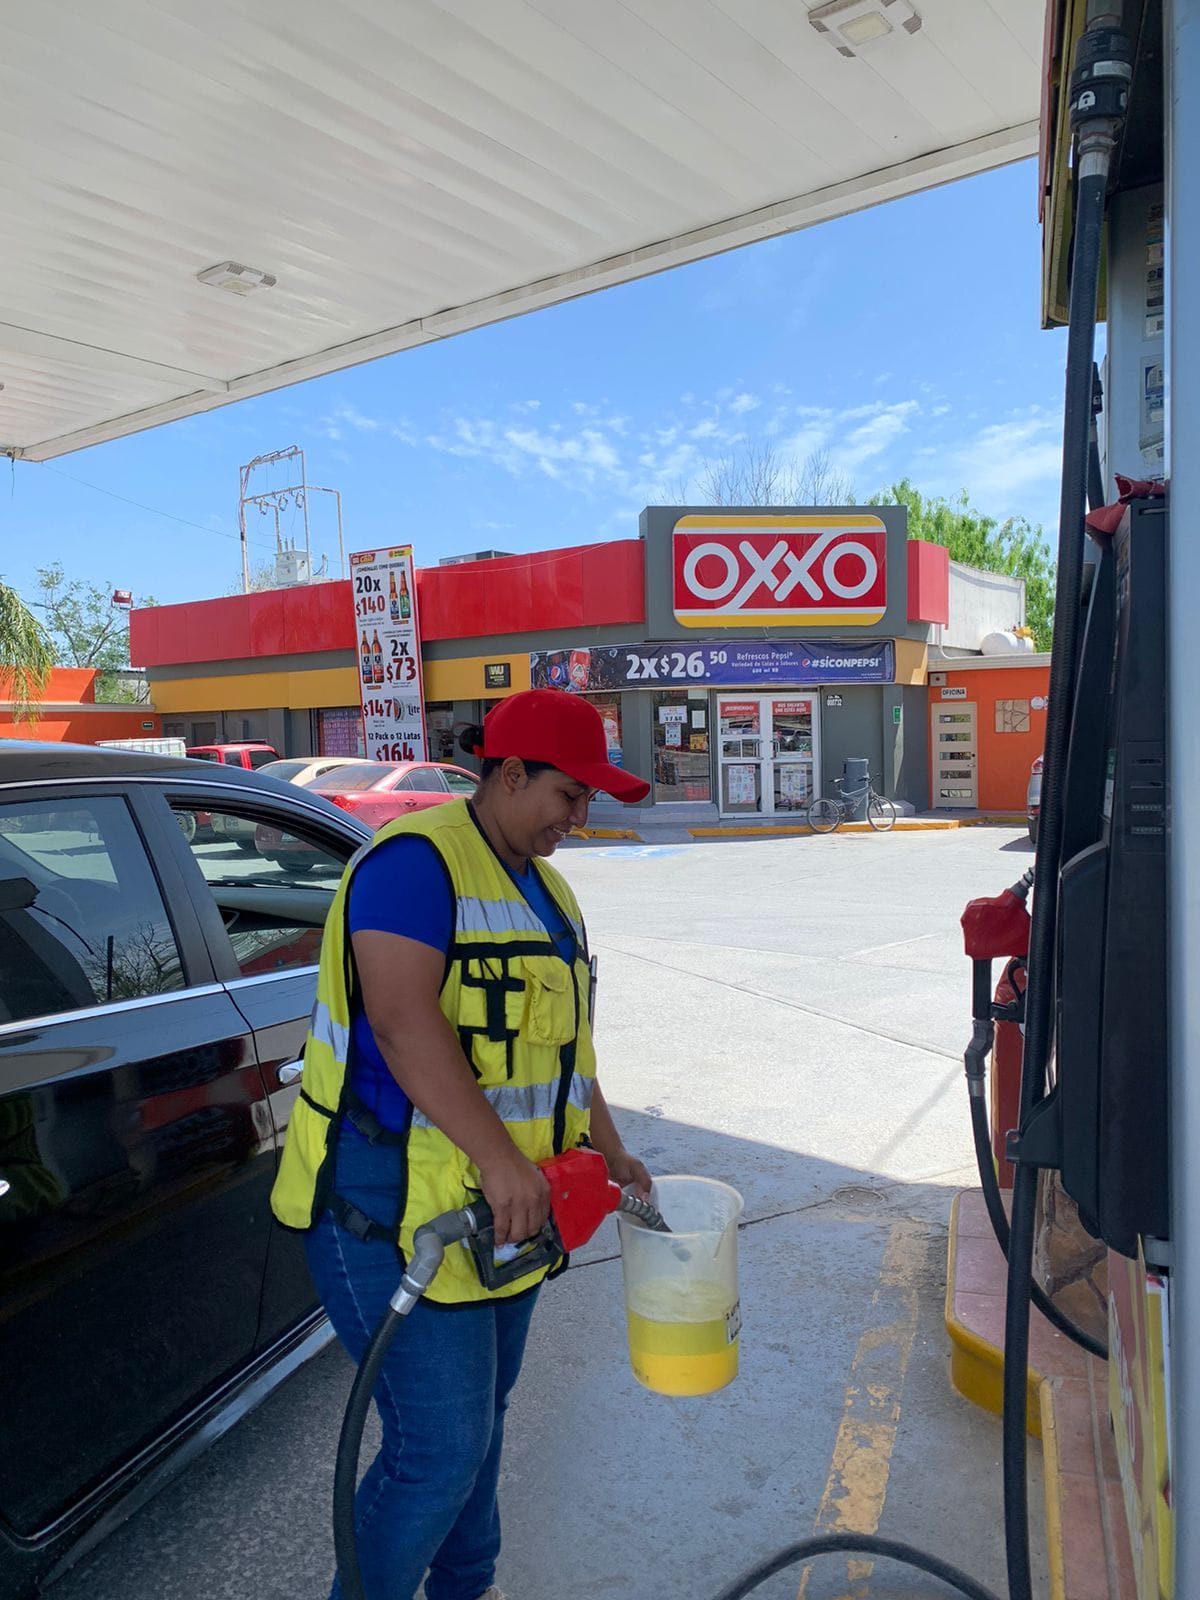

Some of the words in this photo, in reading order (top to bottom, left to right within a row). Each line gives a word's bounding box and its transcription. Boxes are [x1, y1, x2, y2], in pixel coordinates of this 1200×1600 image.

[683, 535, 878, 609] OXXO
[356, 575, 381, 594] 20x
[356, 595, 385, 618] $140
[390, 639, 409, 656] 2x
[736, 652, 770, 661] Refrescos
[387, 657, 417, 683] $73
[942, 688, 965, 696] OFICINA
[363, 699, 393, 718] $147
[368, 732, 374, 740] 12
[375, 732, 389, 740] Pack
[396, 732, 402, 740] 12
[403, 732, 421, 740] Latas
[376, 742, 415, 761] $164
